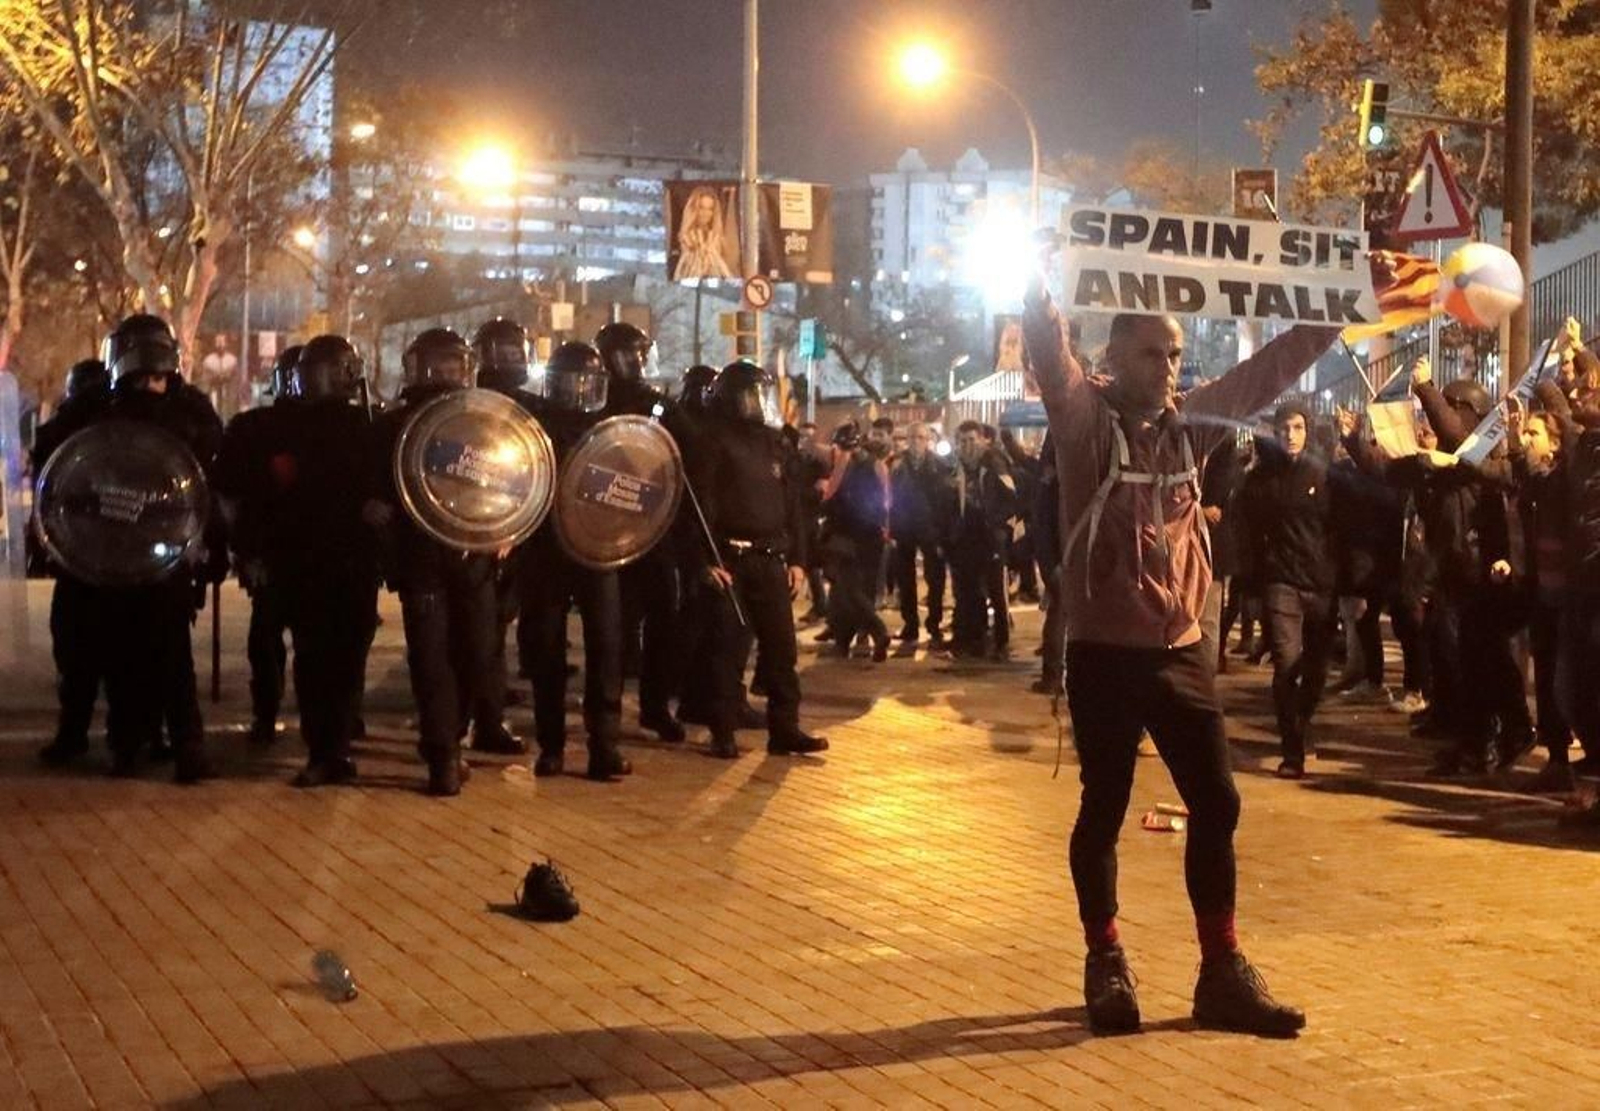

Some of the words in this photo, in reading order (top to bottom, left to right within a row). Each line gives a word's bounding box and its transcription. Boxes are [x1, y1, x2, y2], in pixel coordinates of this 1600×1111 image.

[1070, 210, 1264, 265] SPAIN,
[1280, 229, 1360, 271] SIT
[1074, 269, 1206, 313] AND
[1219, 280, 1367, 323] TALK
